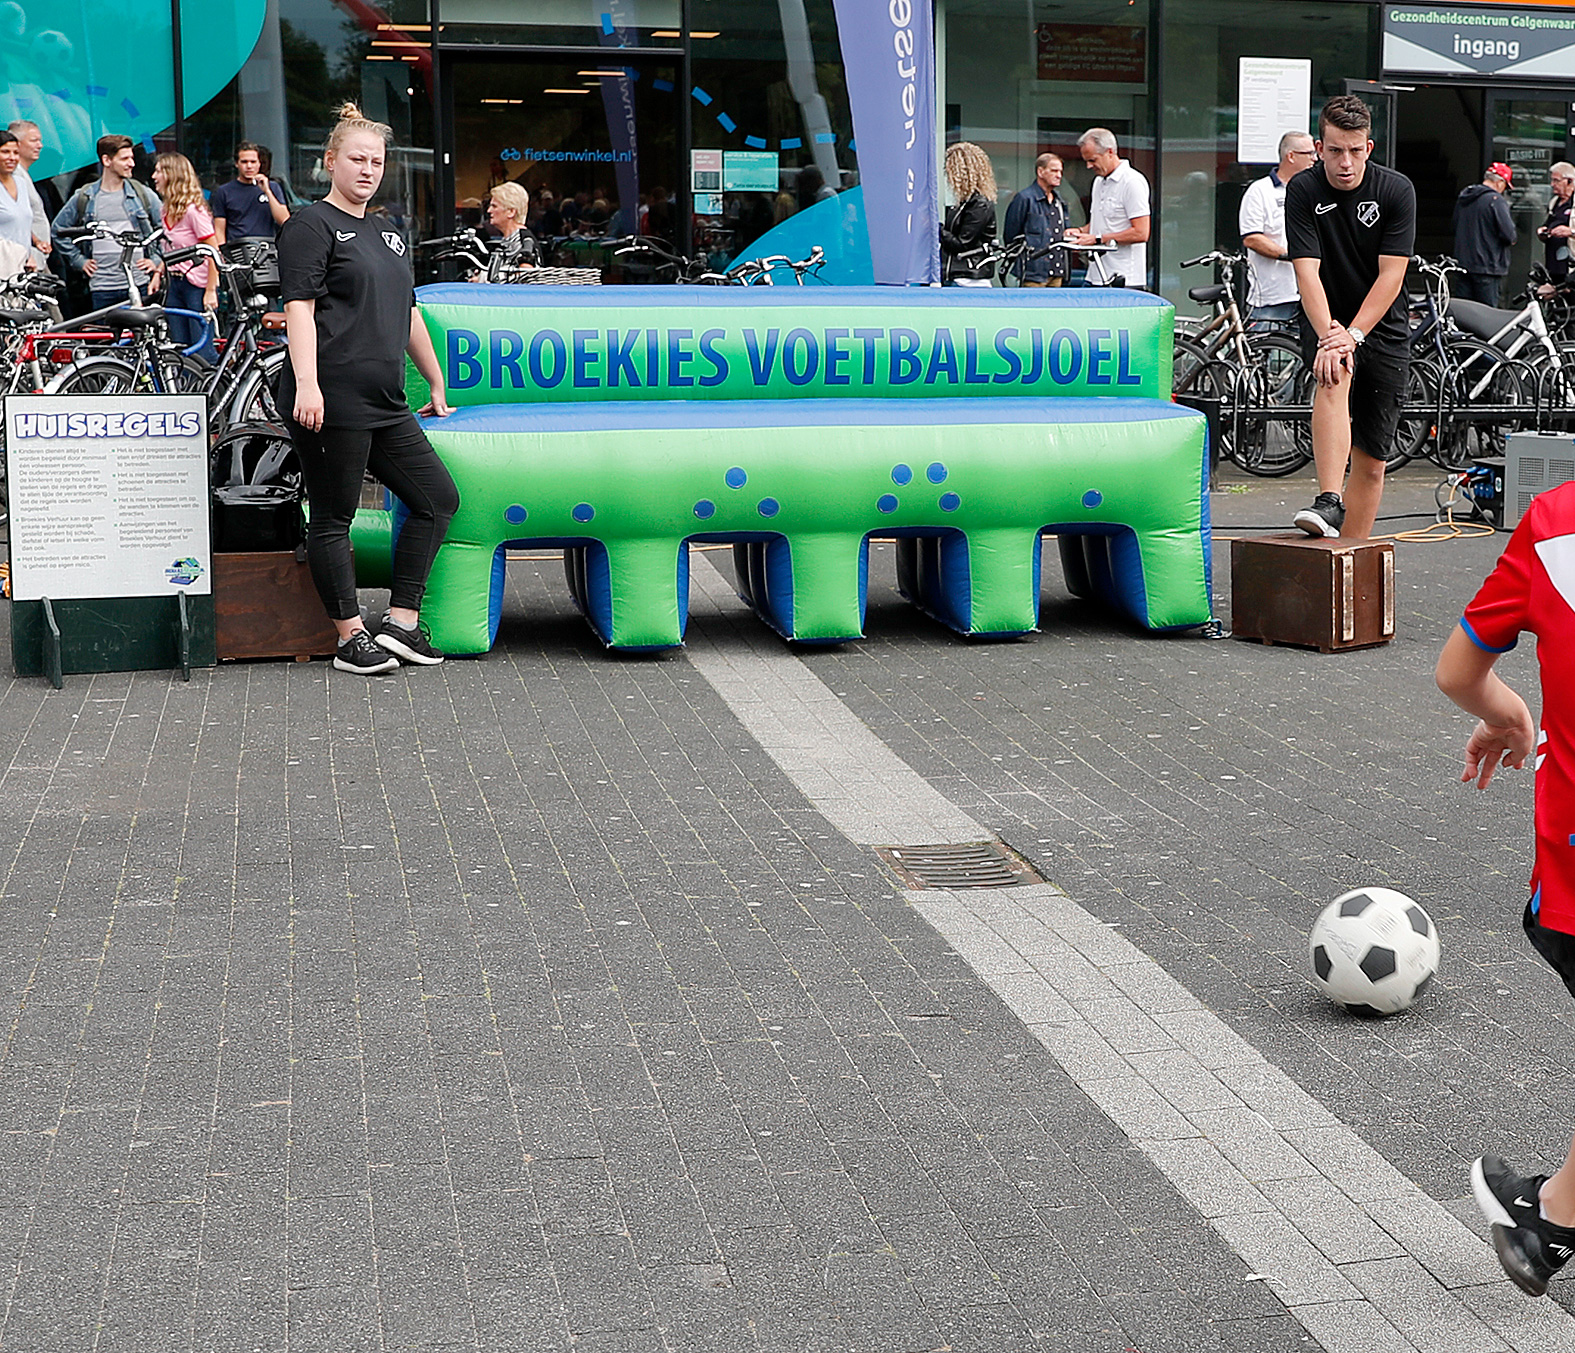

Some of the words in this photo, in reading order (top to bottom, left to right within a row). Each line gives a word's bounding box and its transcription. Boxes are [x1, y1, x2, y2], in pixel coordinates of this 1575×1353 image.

[1390, 10, 1509, 27] Gezondheidscentrum
[1453, 33, 1520, 60] ingang
[524, 148, 632, 162] fietsenwinkel.nl
[446, 328, 730, 389] BROEKIES
[742, 327, 1141, 387] VOETBALSJOEL
[14, 412, 201, 439] HUISREGELS
